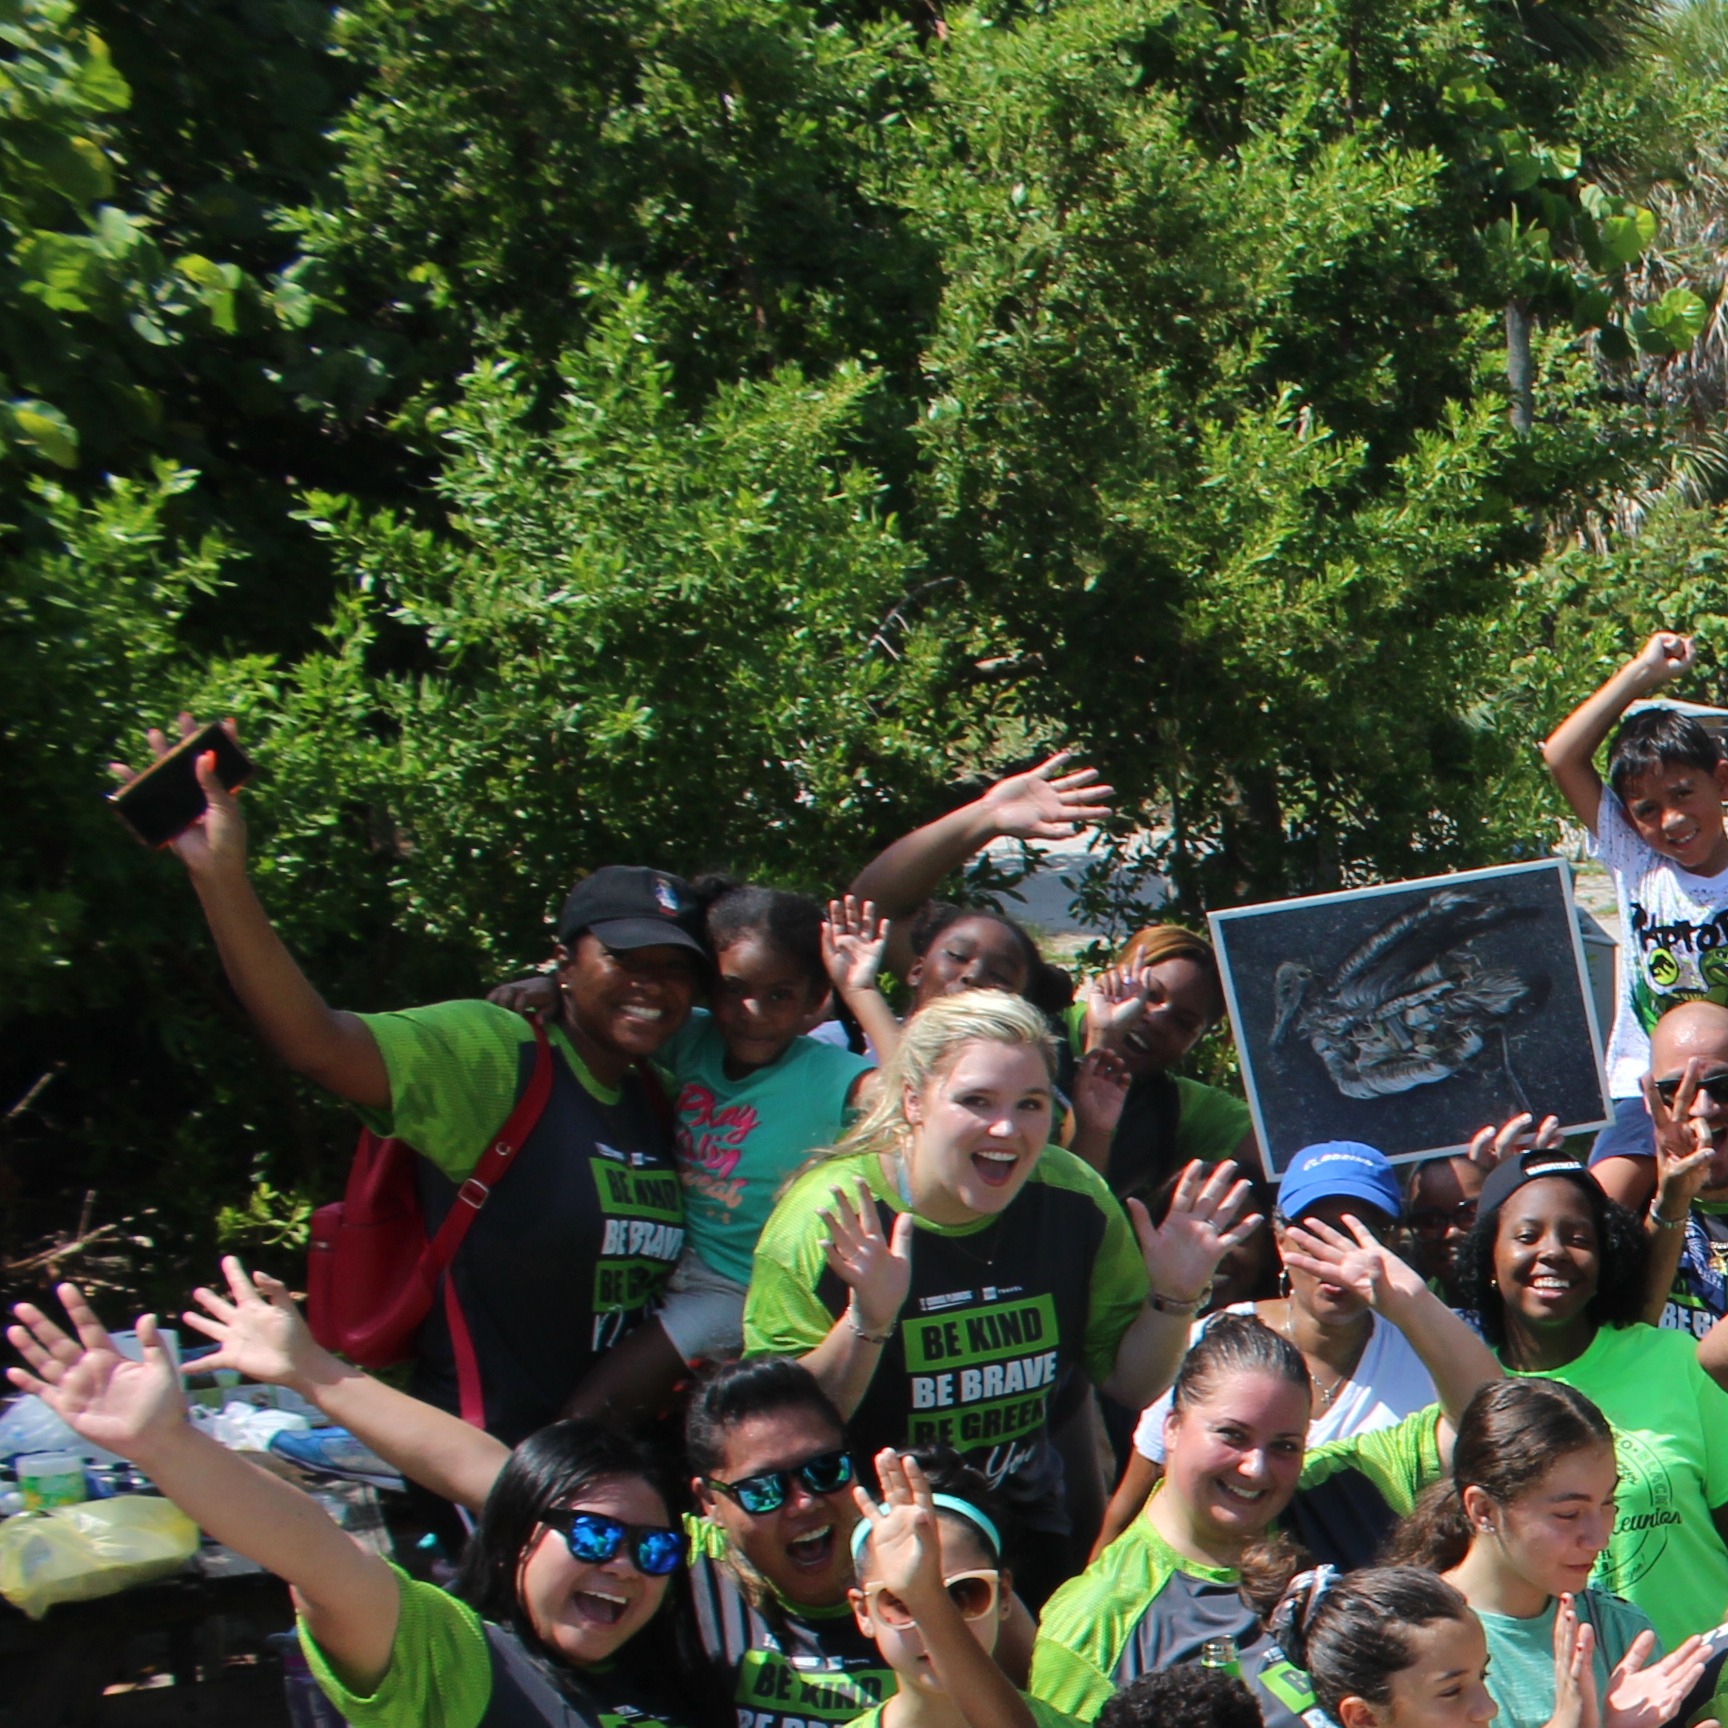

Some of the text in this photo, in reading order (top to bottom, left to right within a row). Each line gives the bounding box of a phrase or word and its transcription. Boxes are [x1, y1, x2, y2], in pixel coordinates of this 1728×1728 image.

[602, 1219, 627, 1254] BE
[922, 1307, 1043, 1361] BE KIND
[1658, 1301, 1691, 1333] BE
[912, 1352, 1056, 1408] BE BRAVE
[754, 1662, 795, 1700] BE
